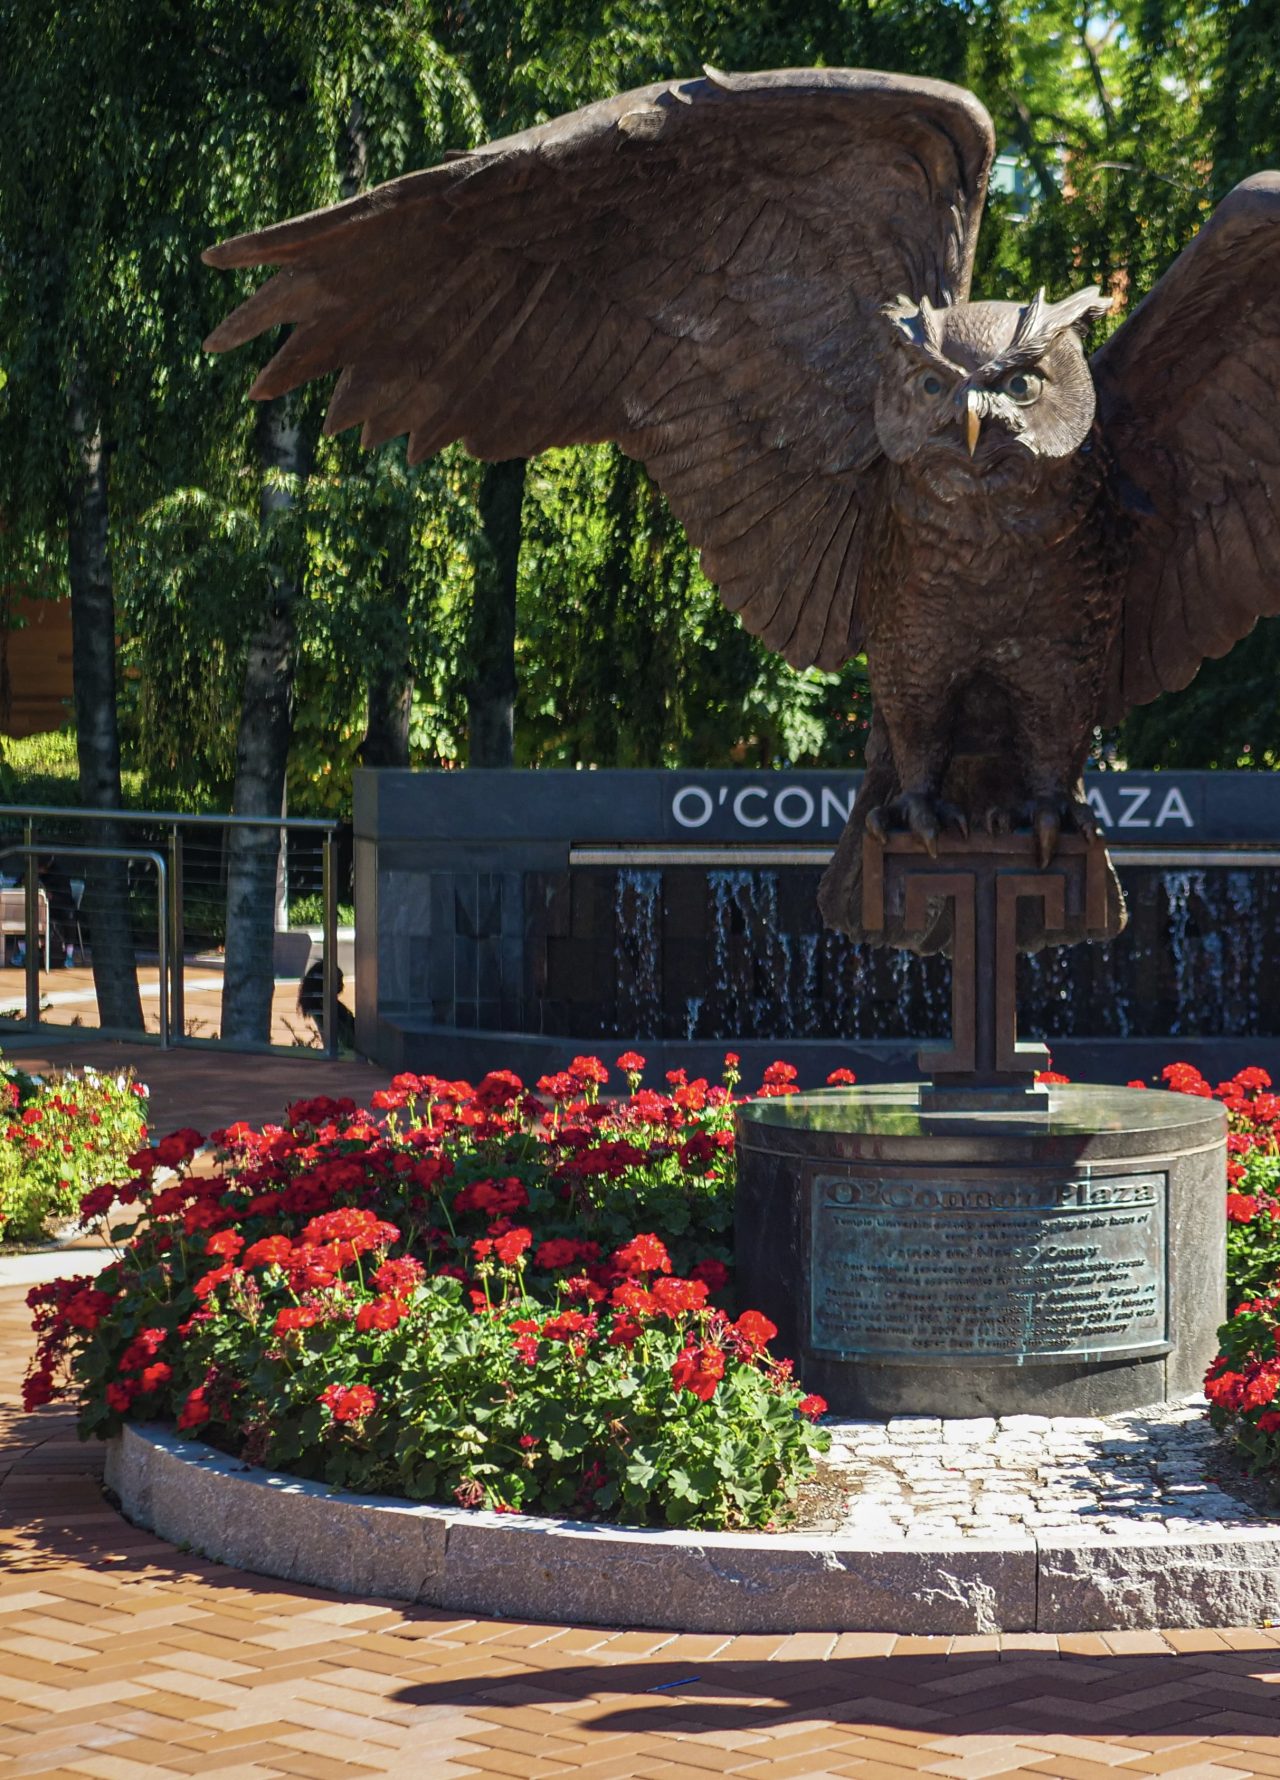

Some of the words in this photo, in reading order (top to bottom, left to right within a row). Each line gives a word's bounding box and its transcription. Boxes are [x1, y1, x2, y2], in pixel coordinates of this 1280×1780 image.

[672, 786, 855, 829] O'CON
[1083, 786, 1195, 829] AZA
[827, 1182, 1034, 1208] O'Connor
[1053, 1182, 1155, 1207] Plaza
